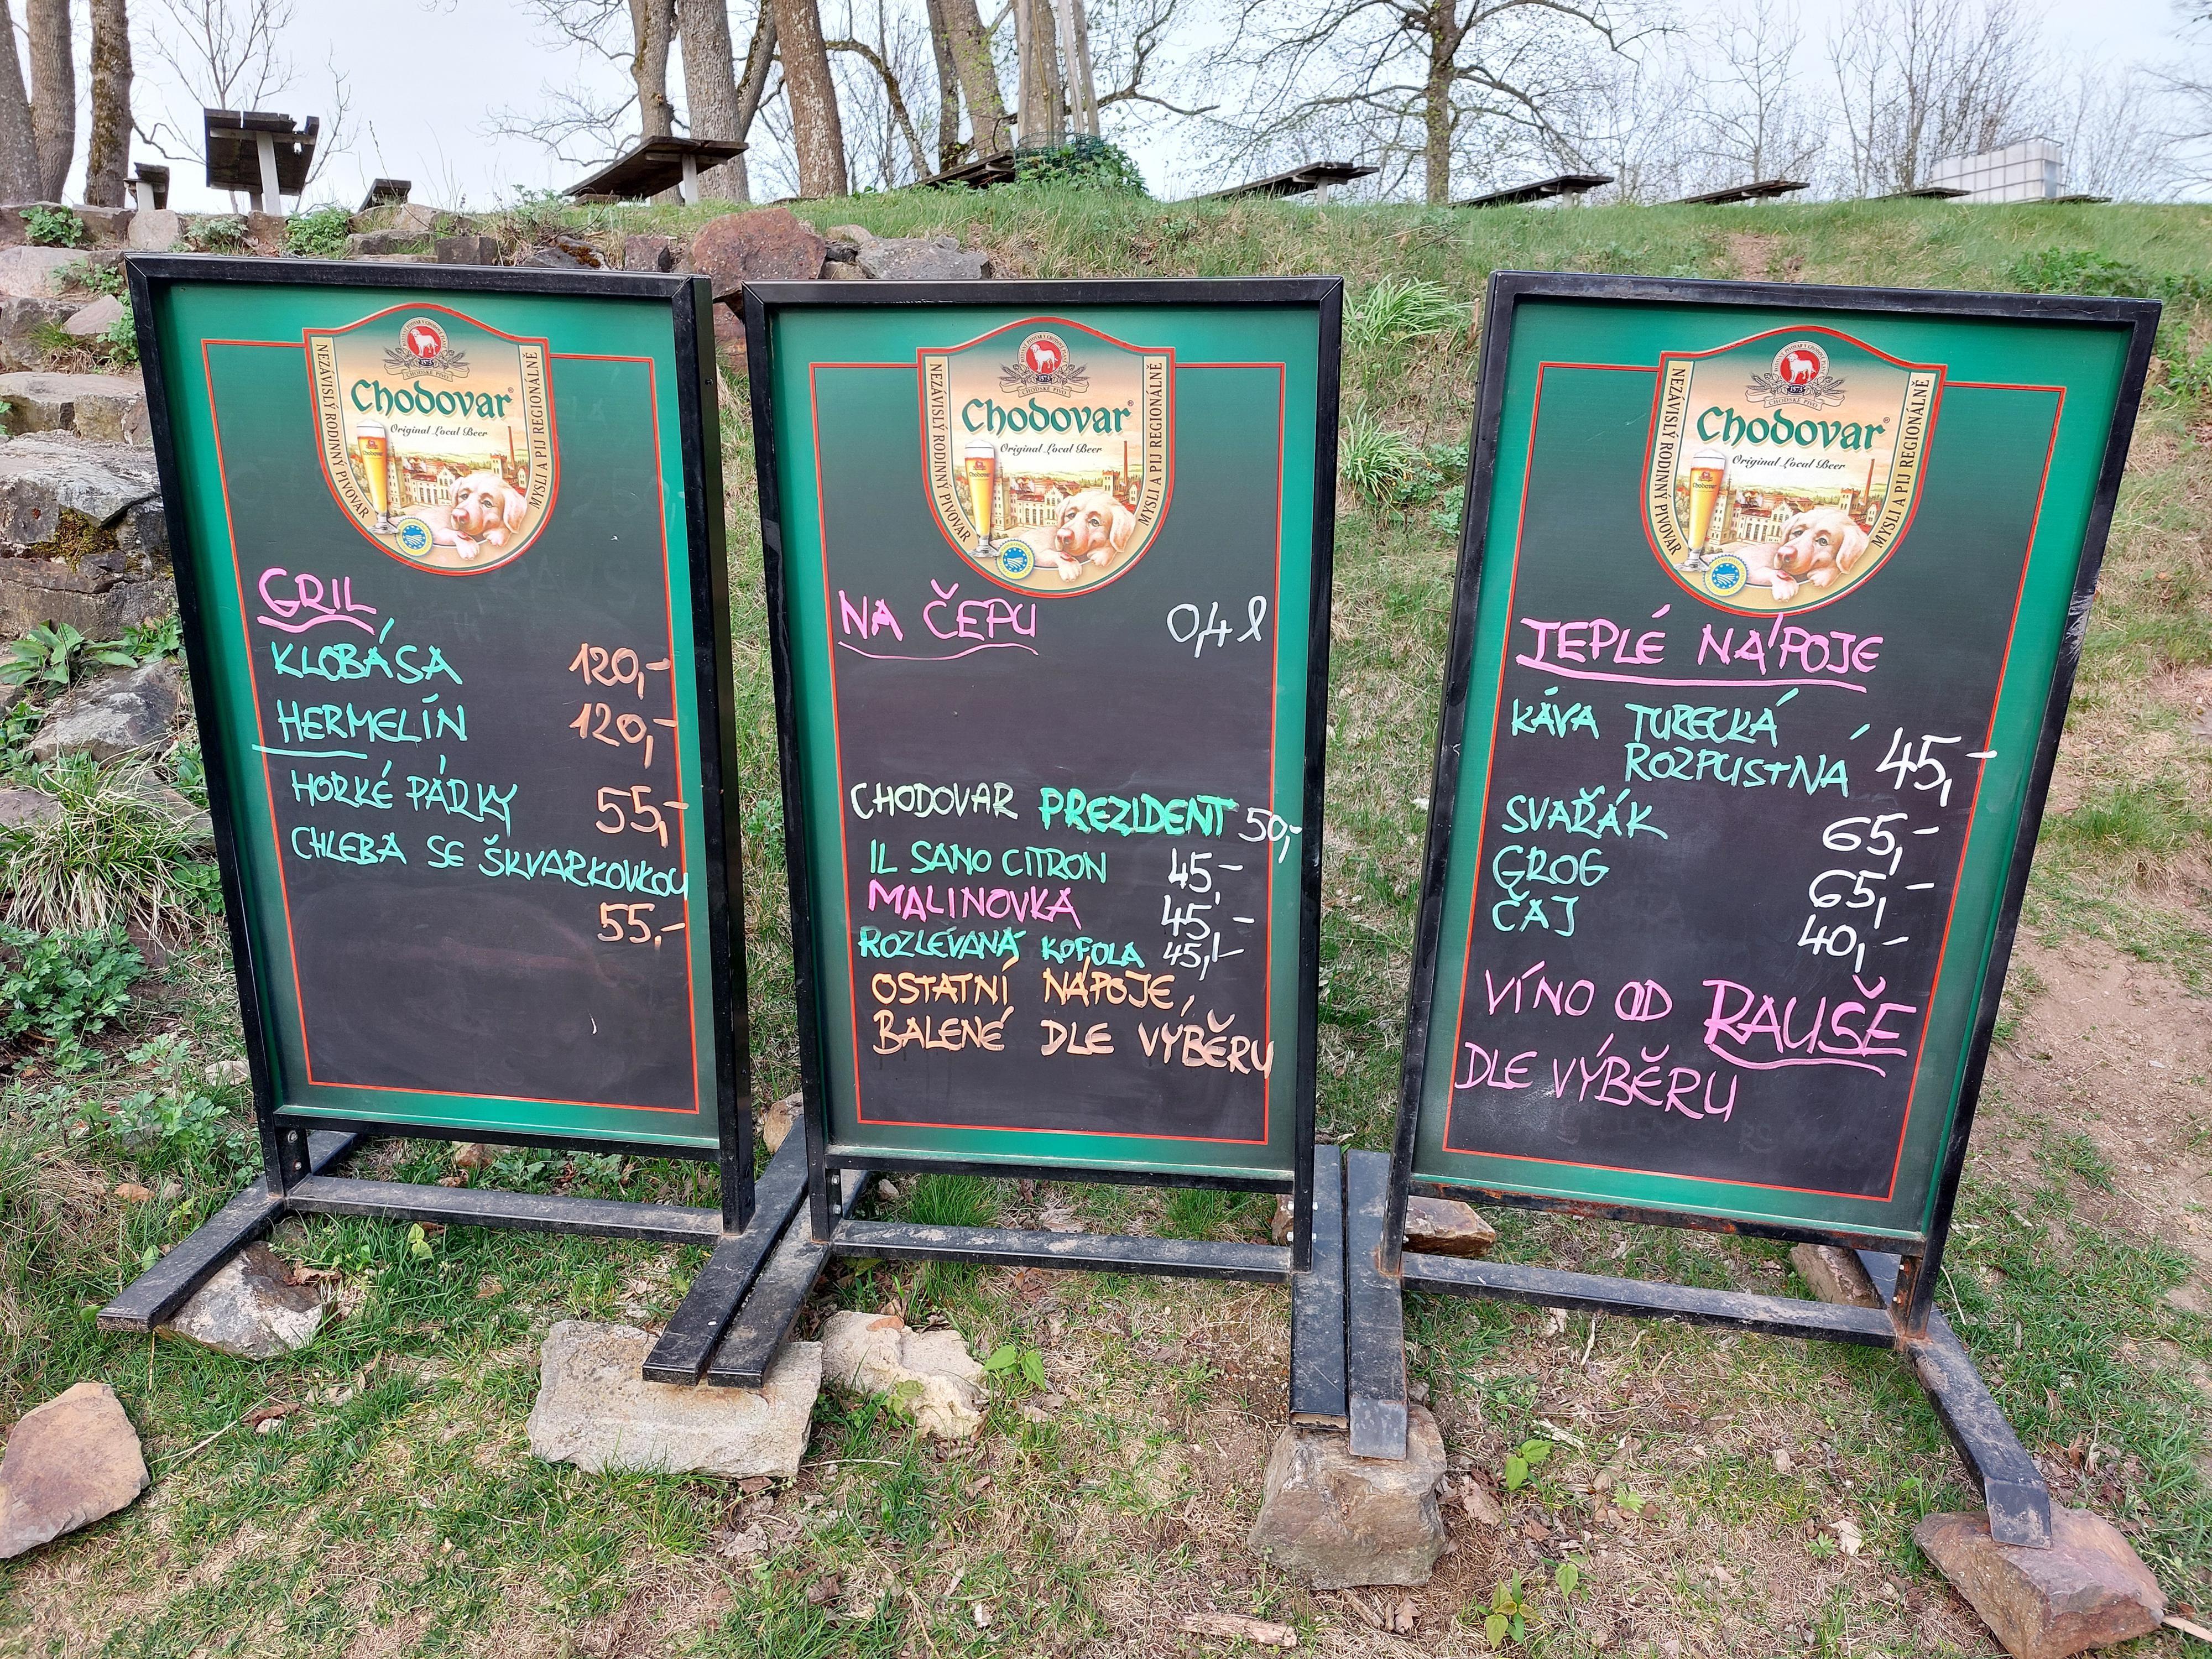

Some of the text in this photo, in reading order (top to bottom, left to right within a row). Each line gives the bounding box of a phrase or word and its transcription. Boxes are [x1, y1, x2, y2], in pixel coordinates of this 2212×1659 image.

[523, 352, 545, 434] REGIONÁLNĚ
[1804, 400, 1818, 408] PIVO
[316, 344, 369, 519] NEZÁVISLÝ RODINNÝ PIVOVAR
[390, 424, 488, 437] Original Local Beer
[534, 440, 547, 458] PIJ
[930, 363, 971, 542] NEZÁVISLÝ RODINNÝ PIVOVAR
[1000, 443, 1102, 456] Original Local Beer
[1138, 363, 1162, 526] MYSLI A PIJ REGIONÁLNĚ
[1654, 368, 1686, 555] NEZÁVISLÝ RODINNÝ PIVOVAR
[1732, 455, 1845, 469] Original Local Beer
[1871, 380, 1929, 548] MYSLI A PIJ REGIONÁLNĚ
[529, 473, 547, 509] MYSLI
[258, 568, 377, 616] GRIL
[838, 579, 1036, 641] NA ČEPU
[271, 618, 463, 685] KLOBÁSA
[1516, 603, 1884, 675] TEPLÉ NÁPOJE
[276, 693, 468, 744] HERMELÍN
[1511, 687, 1799, 748] KÁVA TURECKÁ
[1625, 723, 1871, 798] ROZPUSTNÁ
[291, 760, 393, 810] HORKÉ
[406, 754, 518, 837] PÁRKY
[852, 782, 1019, 820] CHODOVAR
[1040, 787, 1240, 836] PREZIDENT
[1502, 785, 1668, 841] SVAŘÁK
[291, 827, 689, 901] CHLEBA SE ŠKVARKOVKOU
[910, 842, 992, 875] SANO
[1003, 847, 1107, 884] CITRON
[1492, 846, 1610, 888] GROG
[868, 880, 1081, 930] MALINOVKA
[1492, 884, 1579, 937] ČAJ
[1041, 935, 1145, 969] KOFOLA
[871, 956, 1175, 1009] OSTATNÍ NÁPOJE
[1485, 961, 1918, 1057] VÍNO OD RAUŠE
[873, 995, 1275, 1079] BALENÉ DLE VÝBĚRU
[1455, 1034, 1738, 1122] DLE VÝBĚRU
